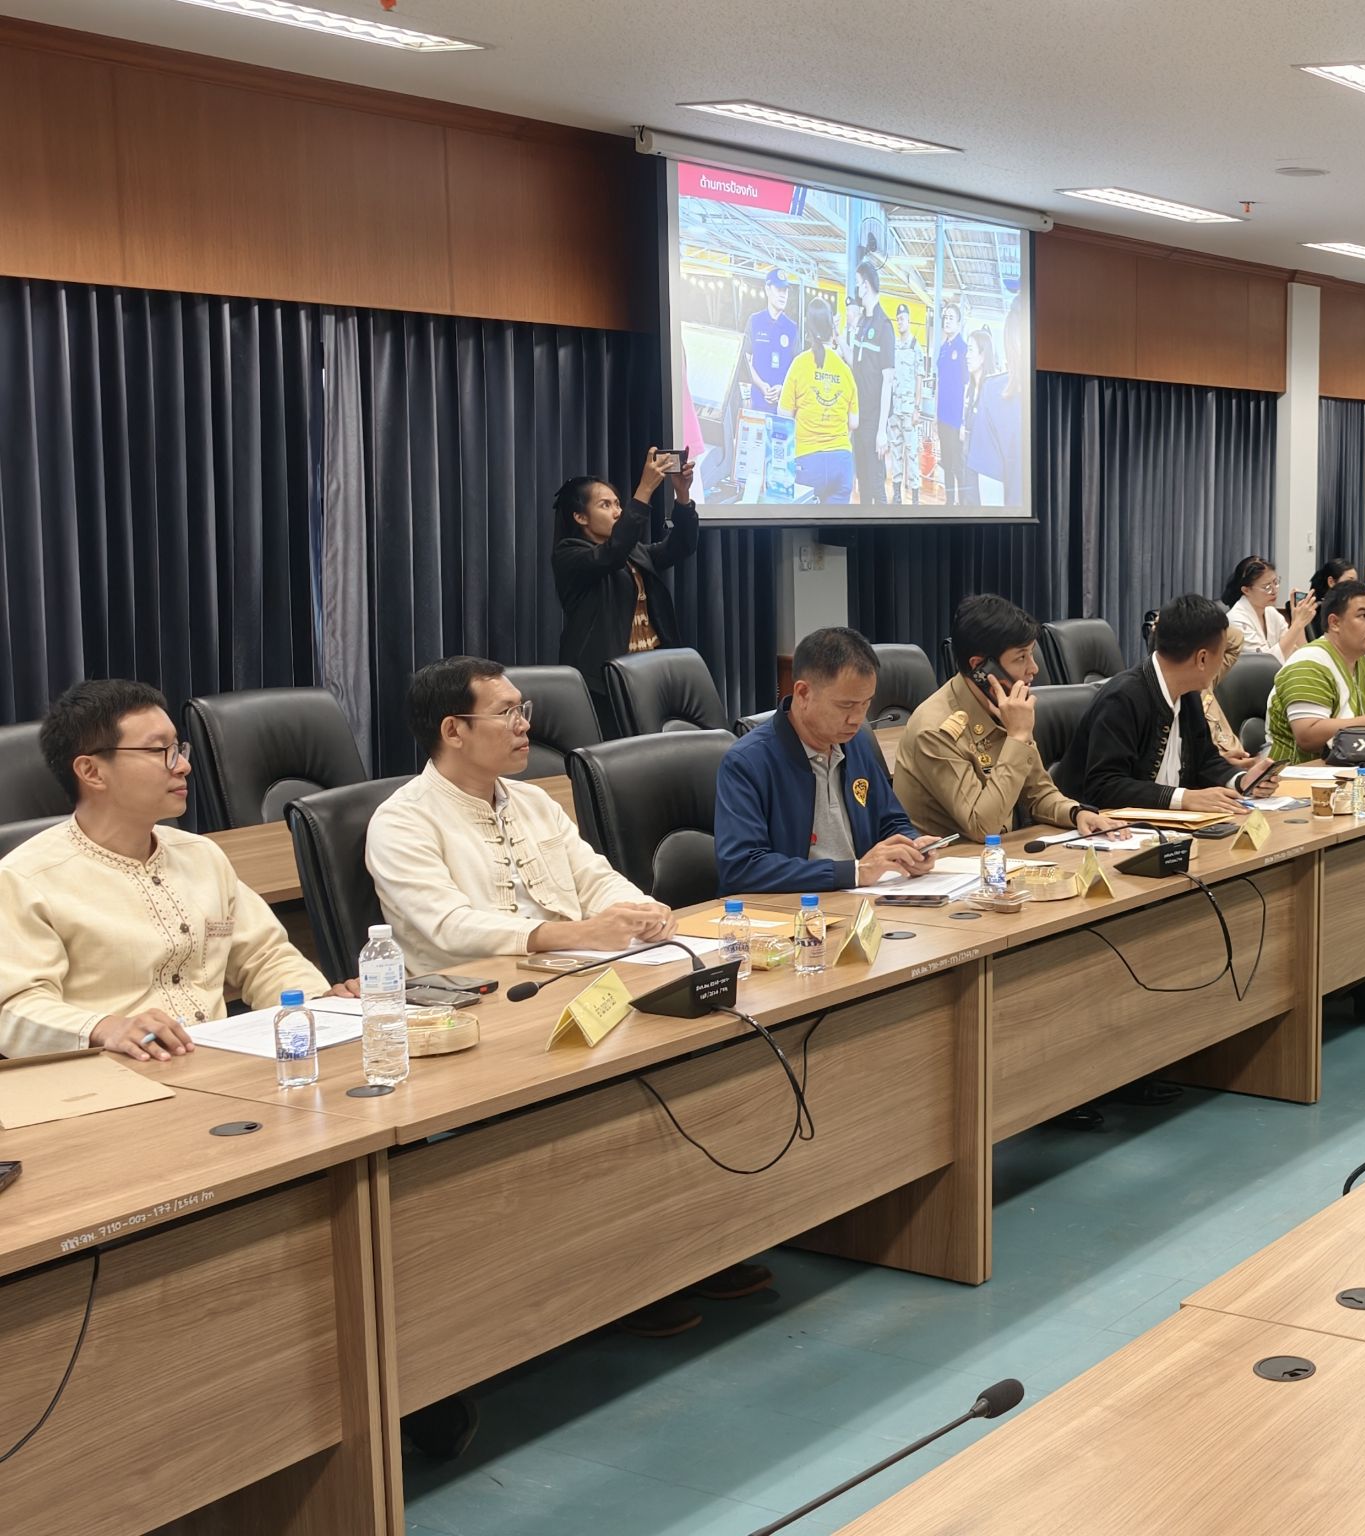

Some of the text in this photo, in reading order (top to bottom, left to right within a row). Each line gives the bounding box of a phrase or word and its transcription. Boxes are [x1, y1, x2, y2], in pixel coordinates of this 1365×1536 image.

[700, 174, 758, 198] ด้านการป้องกัน
